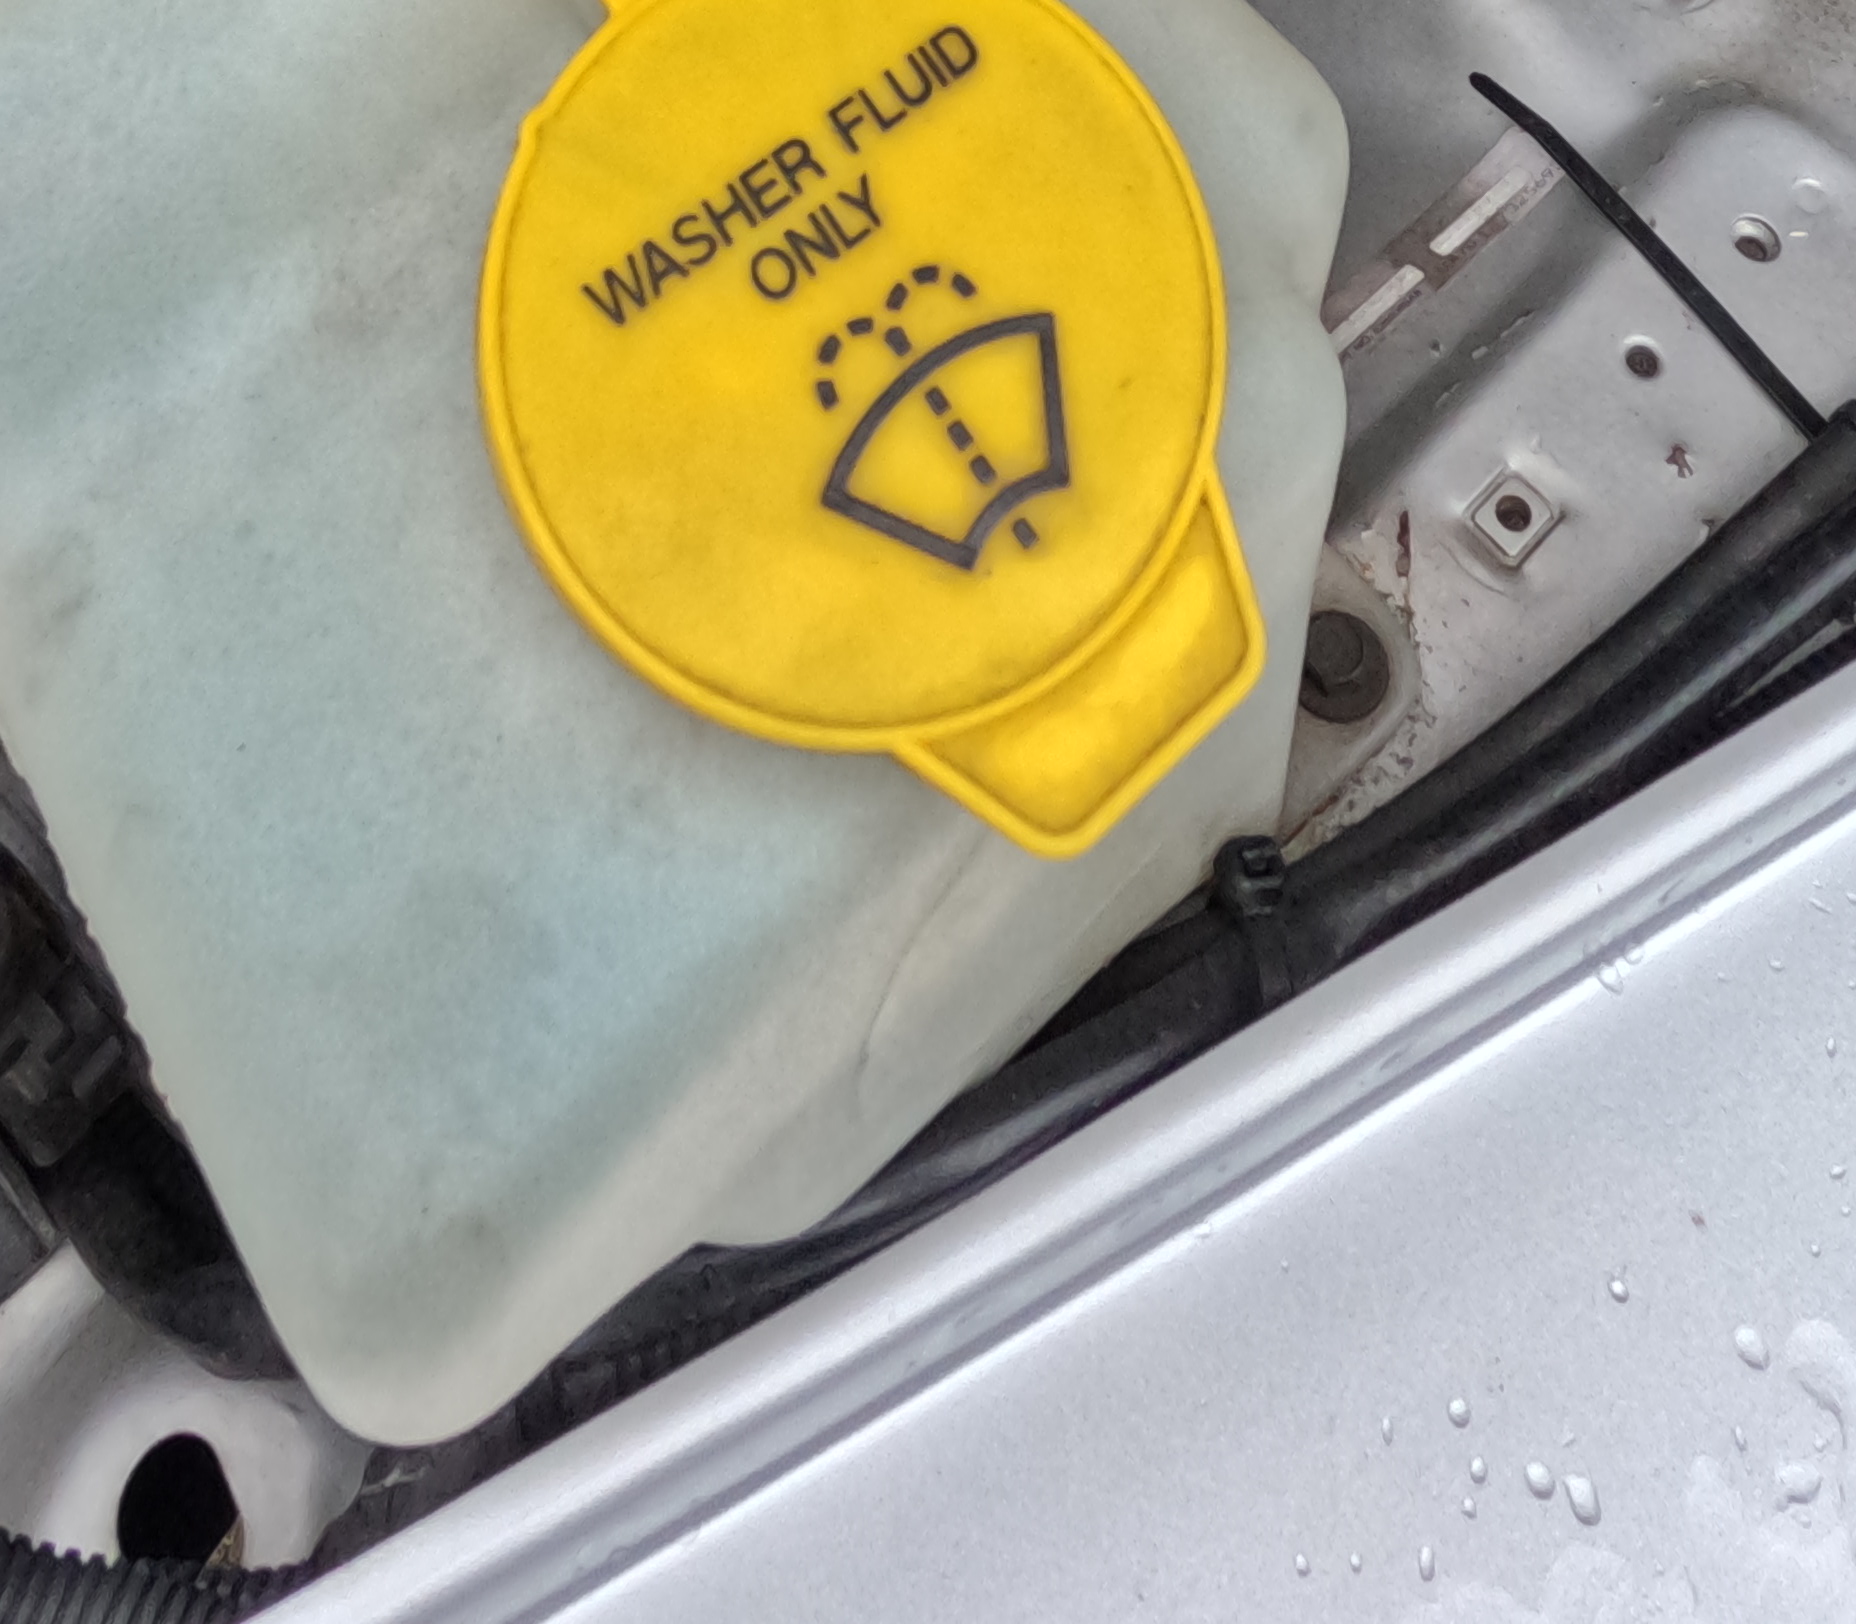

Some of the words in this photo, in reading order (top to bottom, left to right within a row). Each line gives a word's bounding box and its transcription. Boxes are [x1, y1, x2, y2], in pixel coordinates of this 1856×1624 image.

[581, 135, 826, 327] WASHER
[827, 22, 980, 153] FLUID
[749, 173, 885, 303] ONLY
